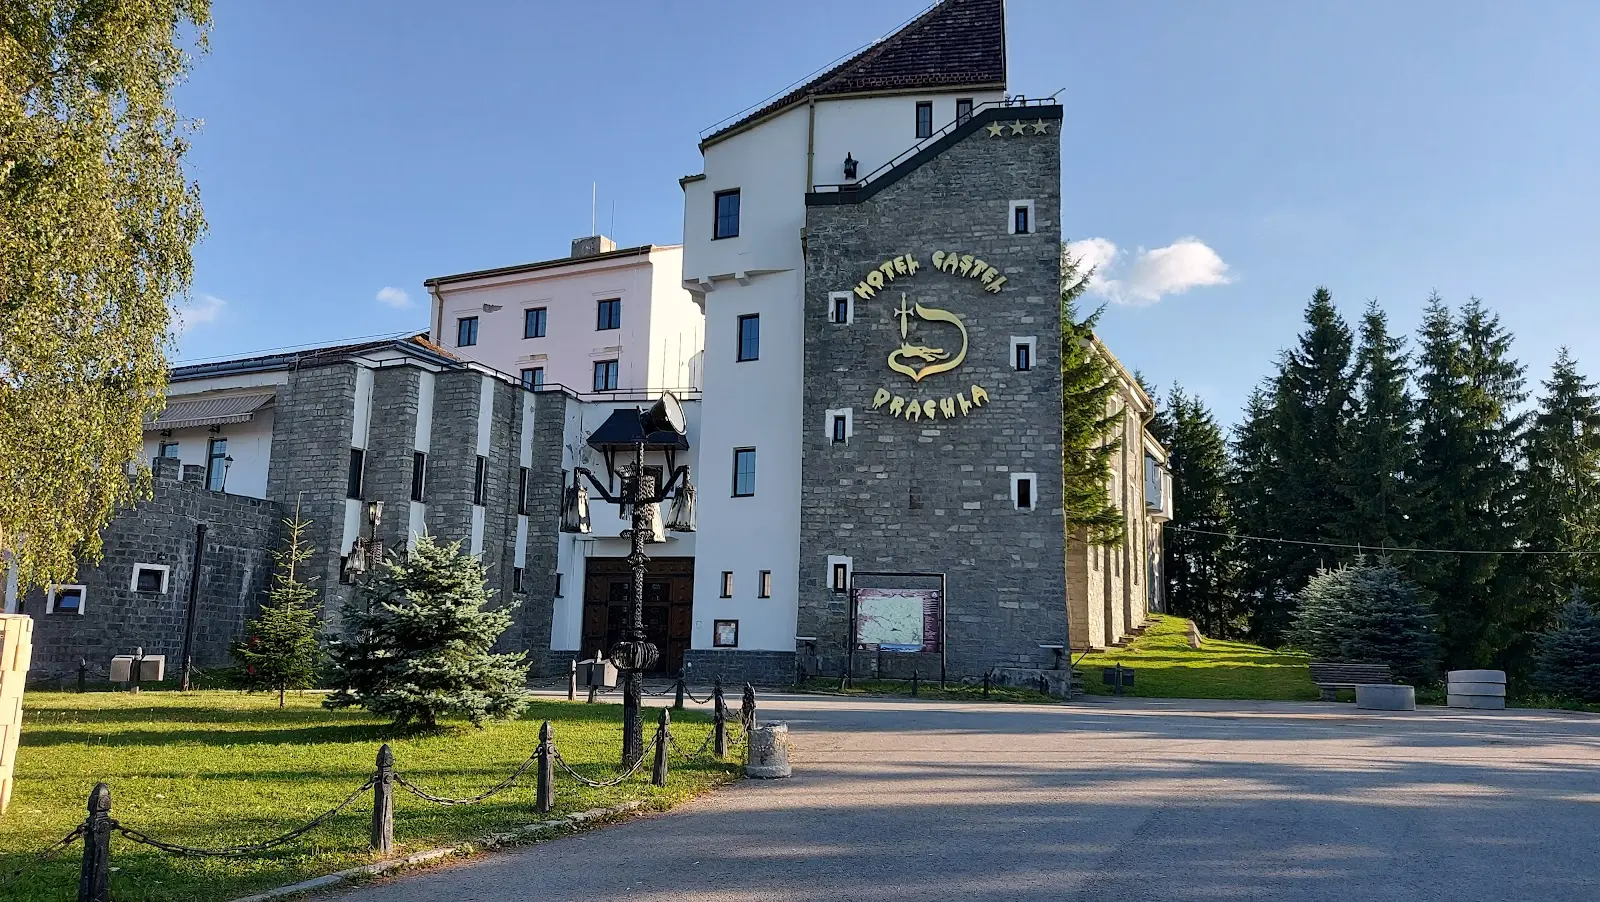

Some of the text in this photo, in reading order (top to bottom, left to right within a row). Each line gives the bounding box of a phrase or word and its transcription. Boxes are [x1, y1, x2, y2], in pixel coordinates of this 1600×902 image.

[853, 250, 1007, 300] HOTEL CASTEL
[872, 384, 990, 422] DRACULA
